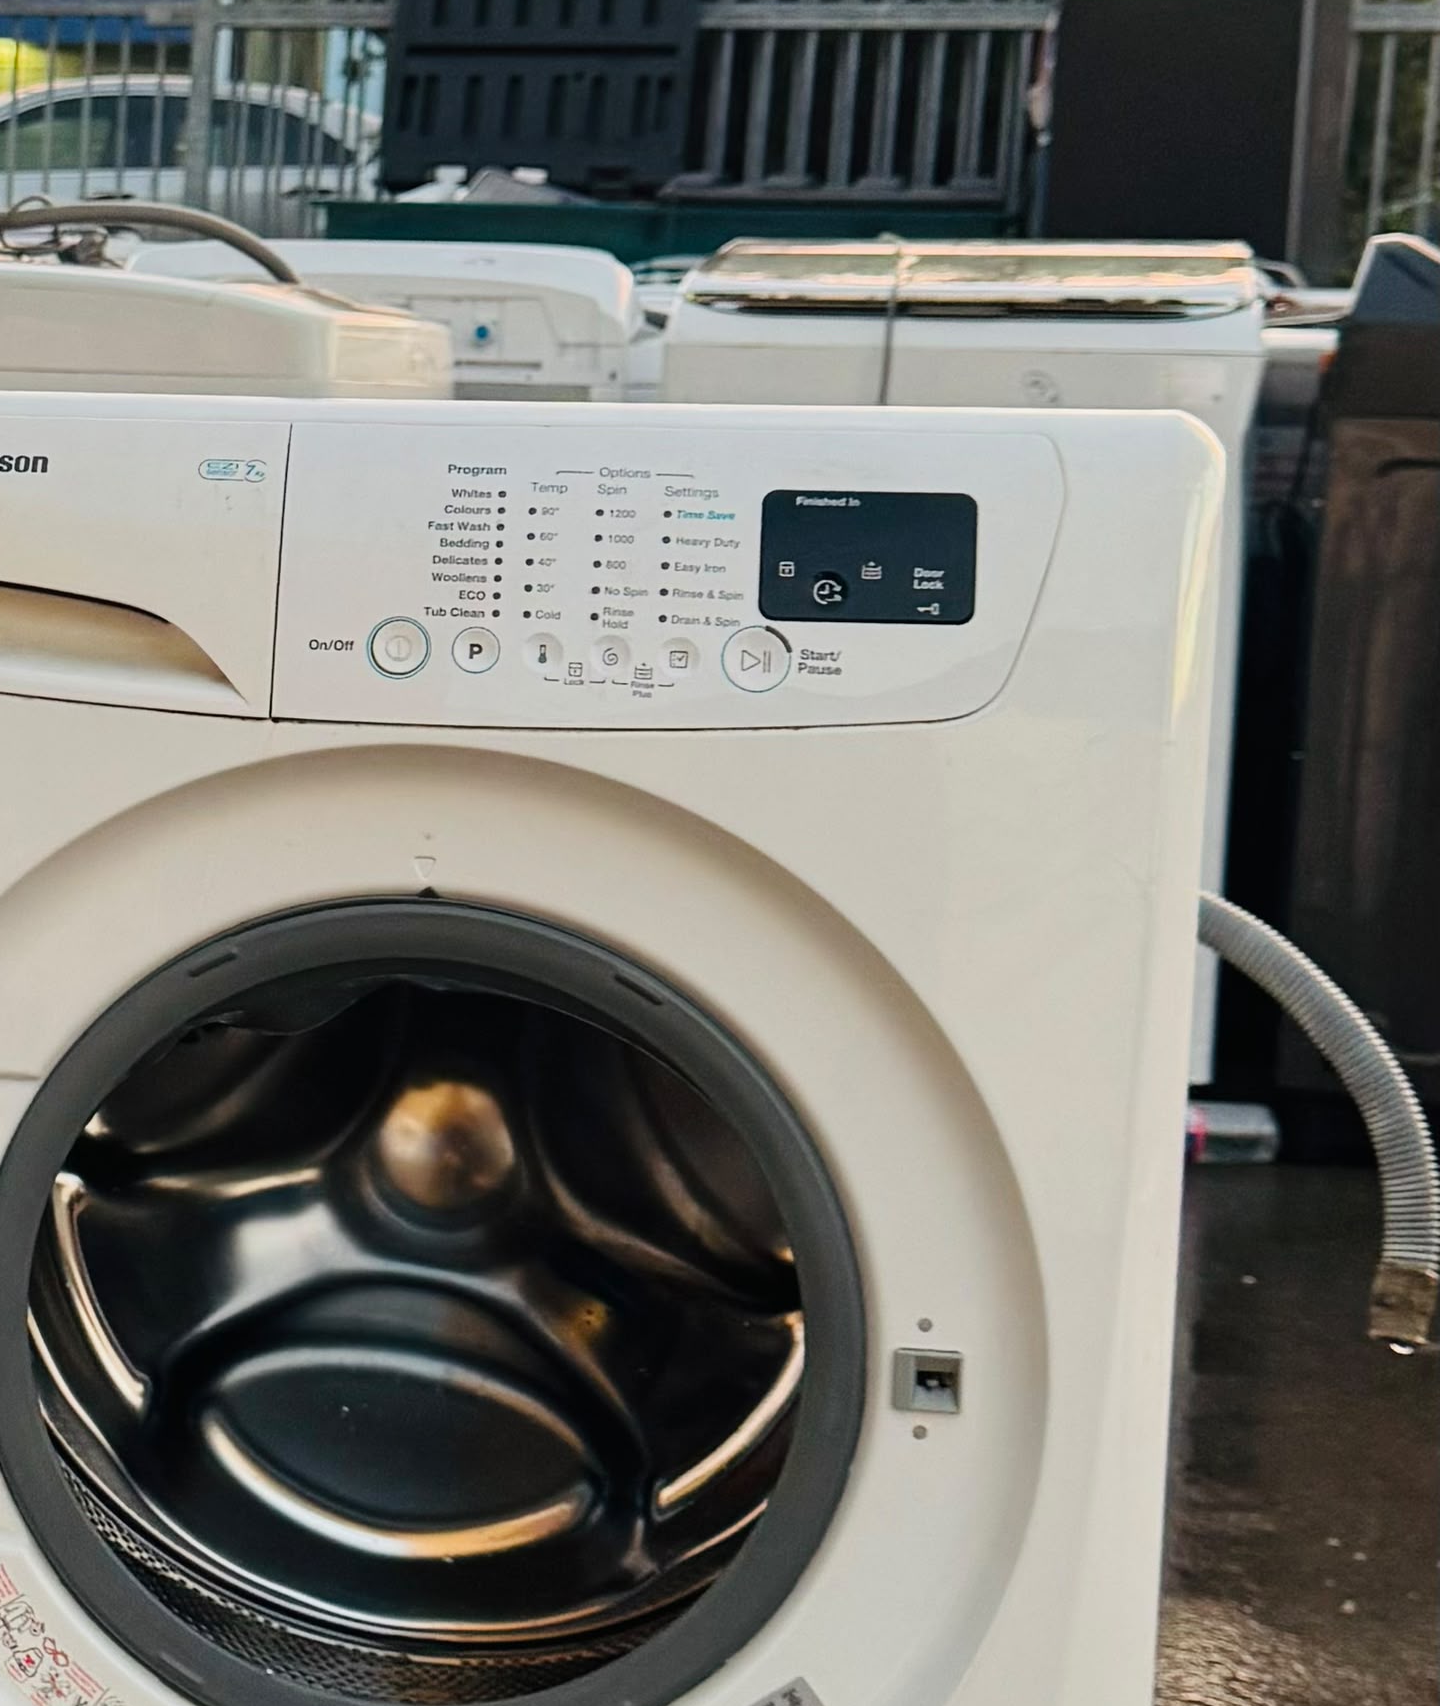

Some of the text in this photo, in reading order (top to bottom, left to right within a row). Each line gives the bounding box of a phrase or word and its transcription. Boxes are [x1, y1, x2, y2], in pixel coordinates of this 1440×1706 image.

[447, 463, 508, 477] Program
[599, 466, 652, 480] Options
[451, 488, 492, 499] Whites
[530, 481, 568, 494] Temp
[597, 483, 628, 496] Spin
[663, 485, 720, 501] Settings
[795, 495, 847, 507] Finished
[443, 504, 492, 515] Colours
[609, 509, 637, 519] 1200
[676, 509, 736, 521] Time Save
[427, 520, 491, 532] Fast Wash
[439, 537, 490, 551] Bedding
[608, 534, 635, 544] 1000
[675, 536, 741, 550] Heavy Duty
[432, 554, 489, 566] Delicates
[605, 560, 627, 570] 800
[674, 562, 727, 574] Easy Iron
[913, 567, 945, 579] Door
[431, 572, 488, 584] Woollens
[913, 579, 945, 590] Lock
[458, 589, 487, 601] ECO
[604, 585, 649, 598] No Spin
[671, 587, 744, 601] Rinse & Spin
[423, 606, 486, 619] Tub Clean
[535, 609, 561, 620] Cold
[603, 606, 635, 617] Rinse
[603, 619, 629, 630] Hold
[671, 614, 741, 628] Drain & Spin
[308, 639, 355, 652] On/Off
[468, 642, 483, 660] P
[799, 648, 843, 662] Start/
[797, 662, 843, 676] Pause
